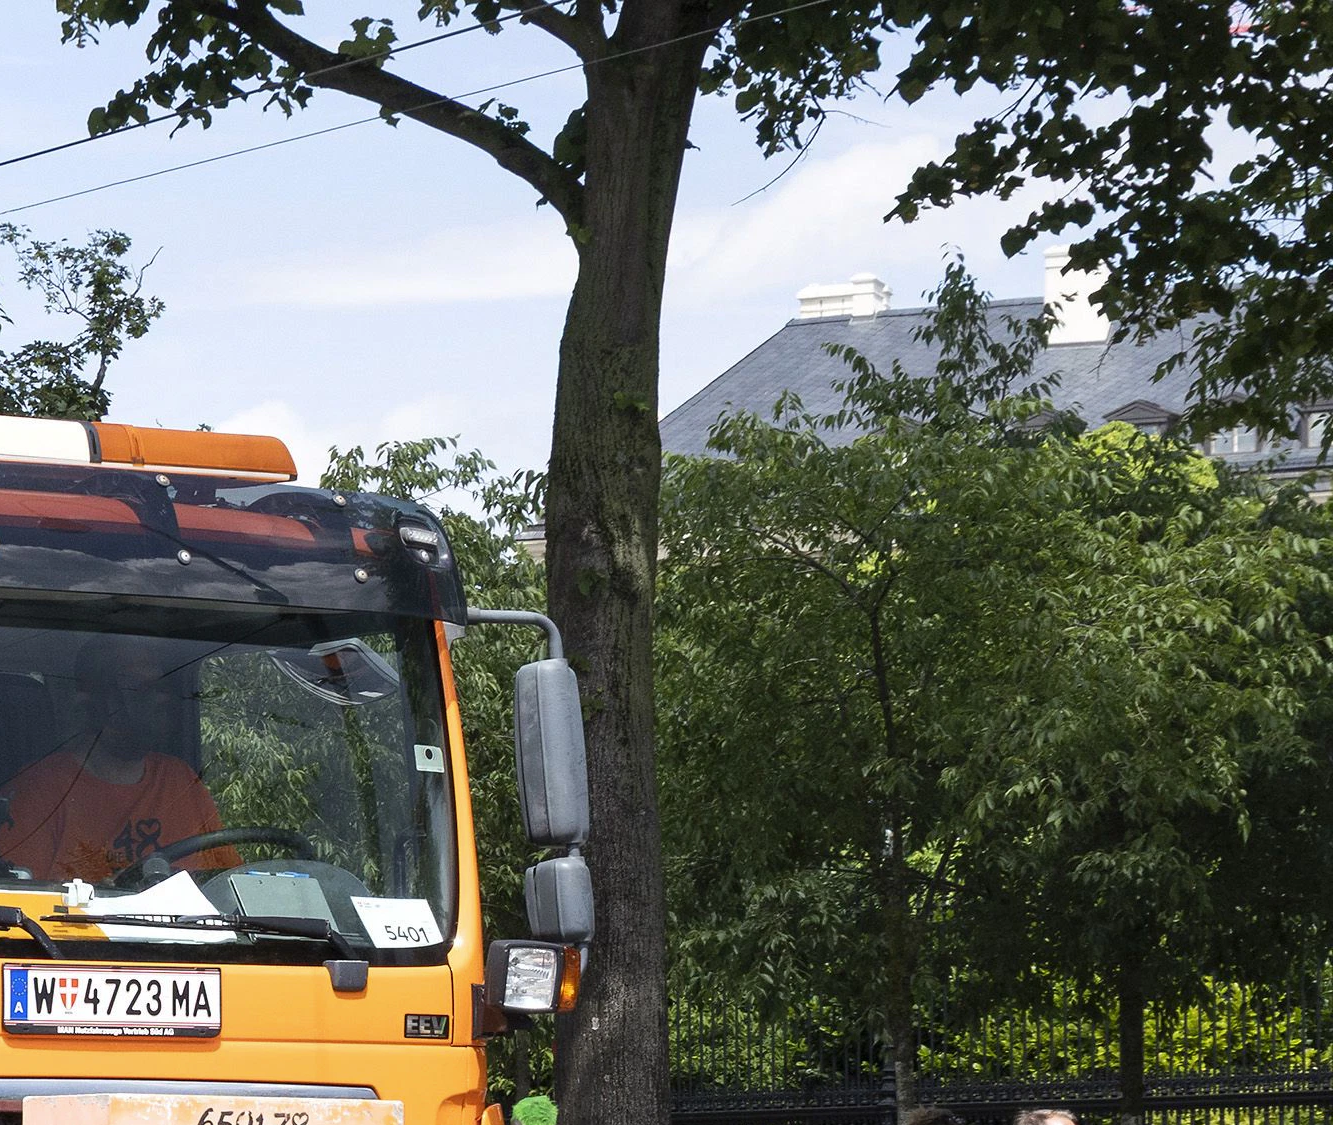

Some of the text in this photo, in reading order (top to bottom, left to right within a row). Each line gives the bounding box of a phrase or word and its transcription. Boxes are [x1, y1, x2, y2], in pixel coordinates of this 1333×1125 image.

[384, 925, 430, 944] 5401
[14, 977, 212, 1018] A W 4723 MA
[406, 1015, 447, 1035] EEV
